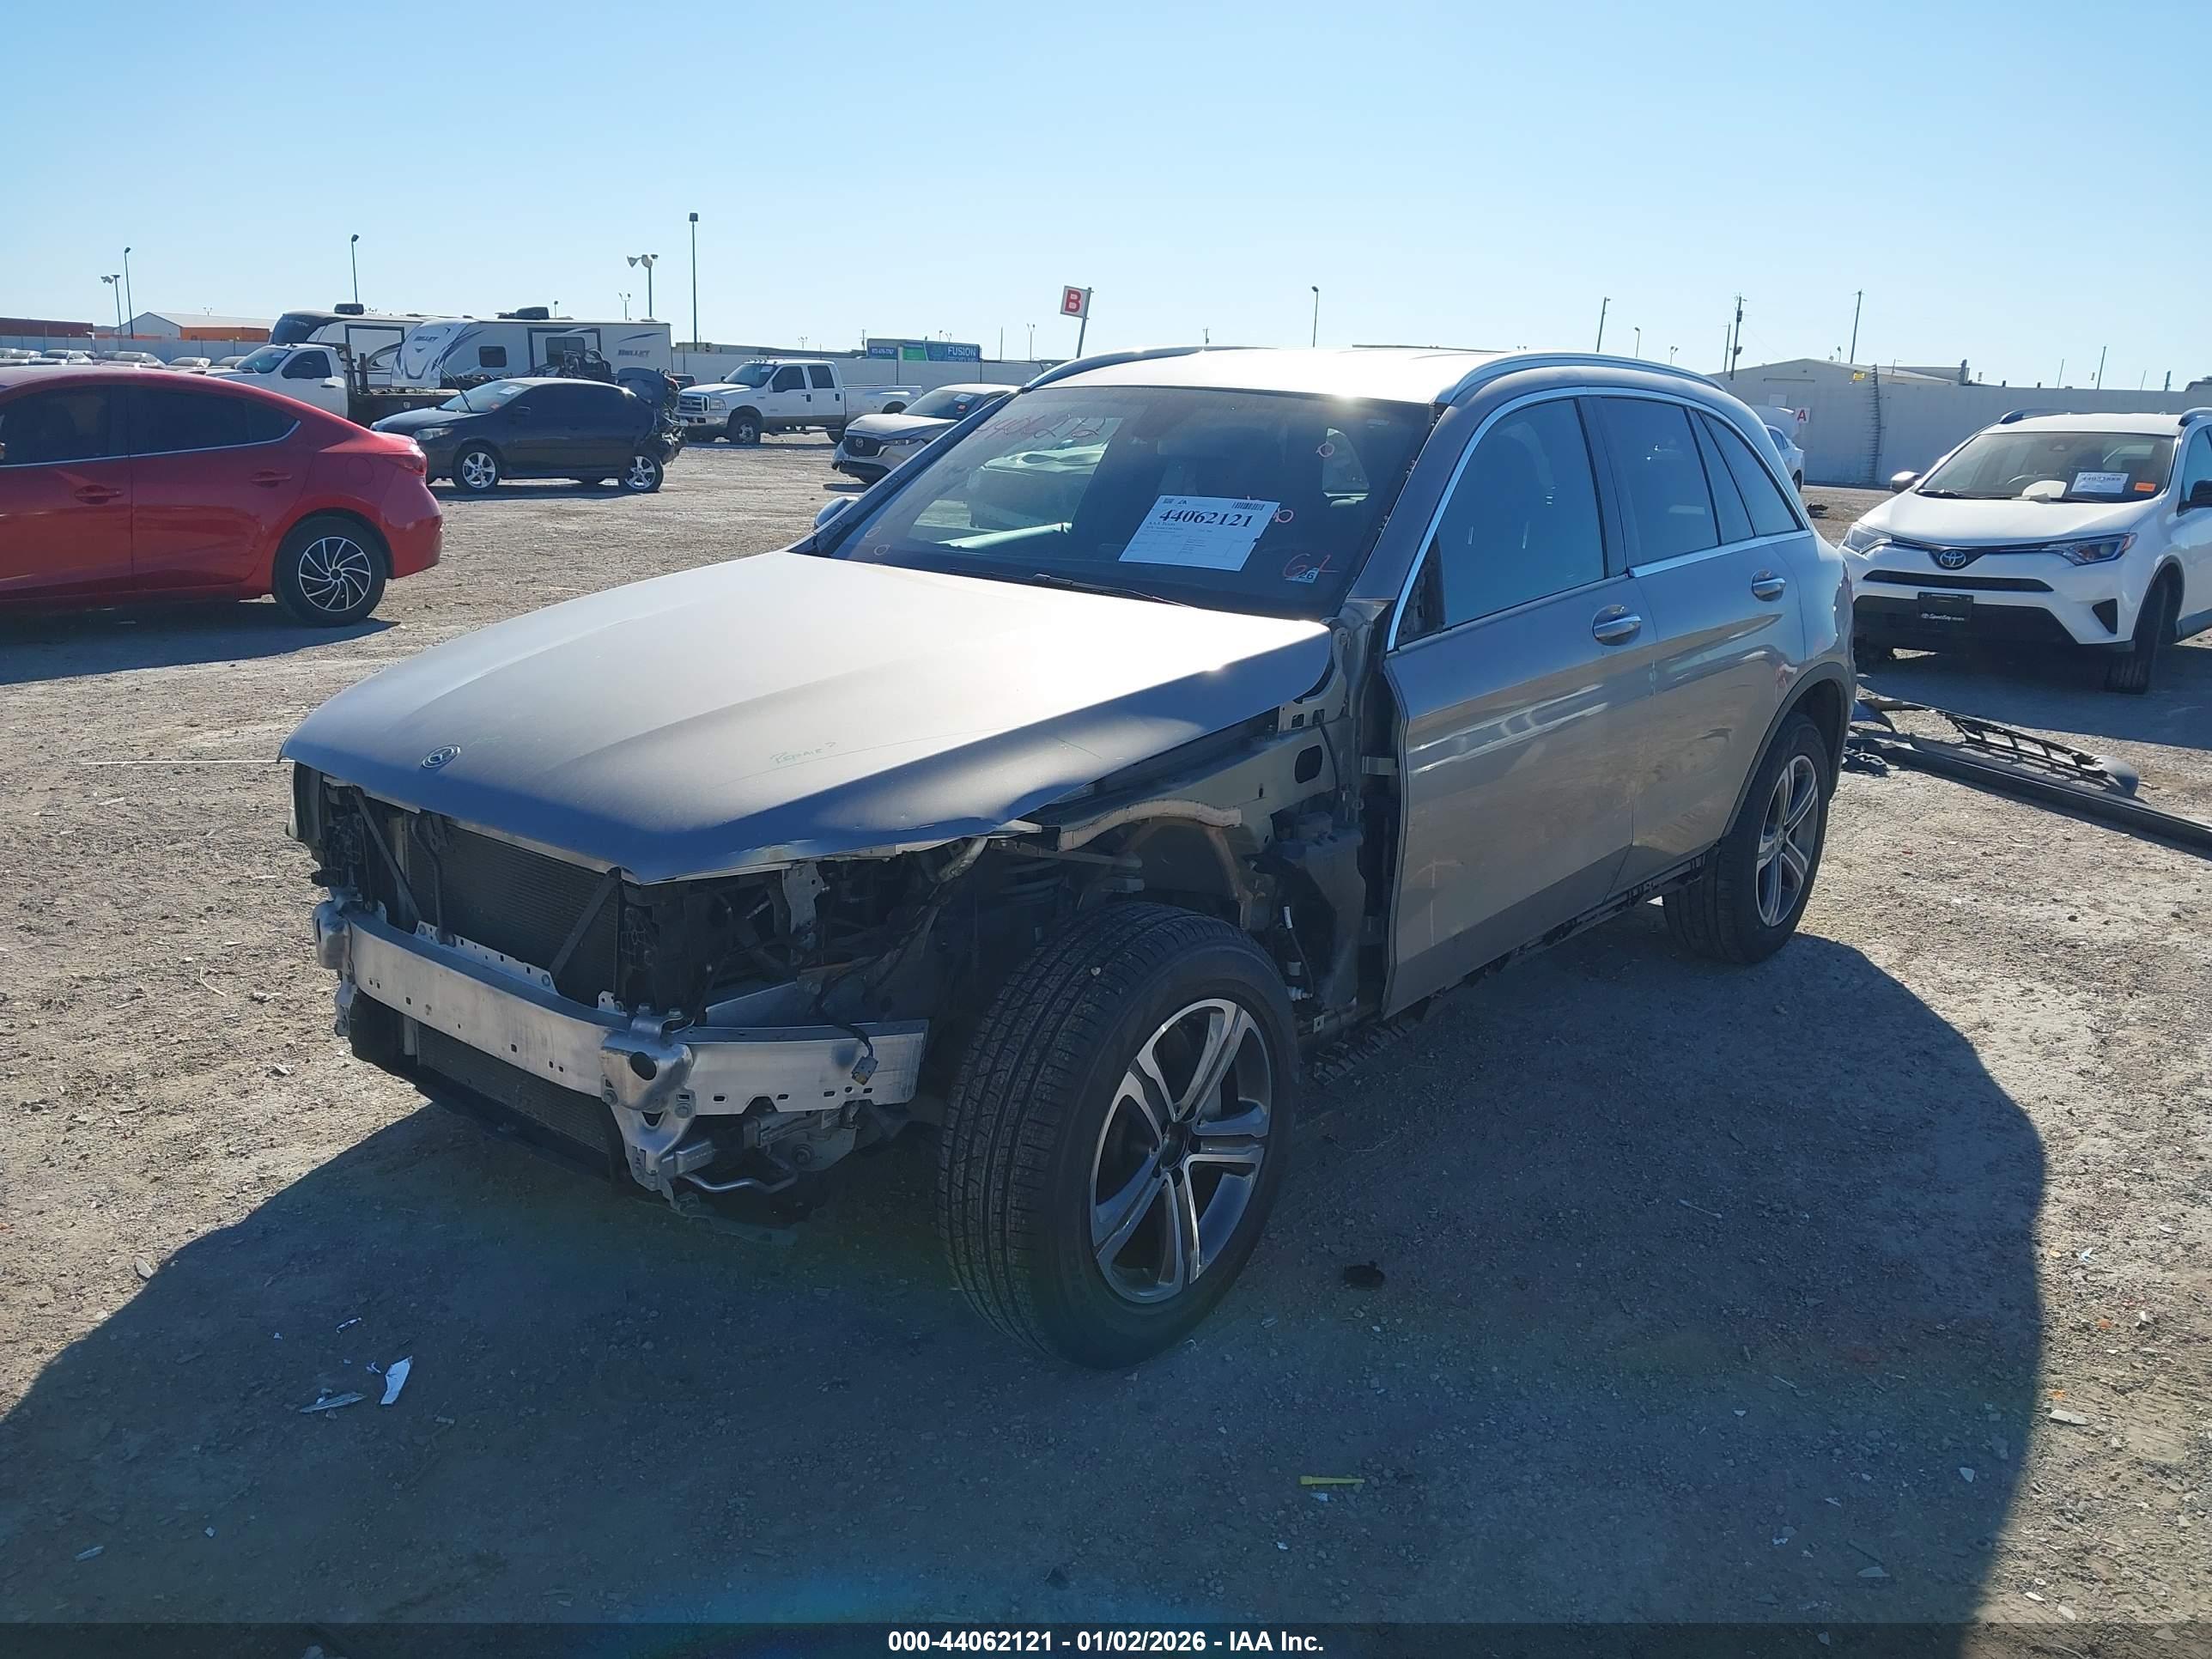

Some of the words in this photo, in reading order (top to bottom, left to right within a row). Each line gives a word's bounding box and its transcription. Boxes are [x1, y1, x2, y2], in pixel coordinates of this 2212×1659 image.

[1065, 289, 1081, 313] B
[947, 345, 976, 357] FUSION
[1797, 409, 1807, 422] A
[1159, 509, 1255, 528] 44062121
